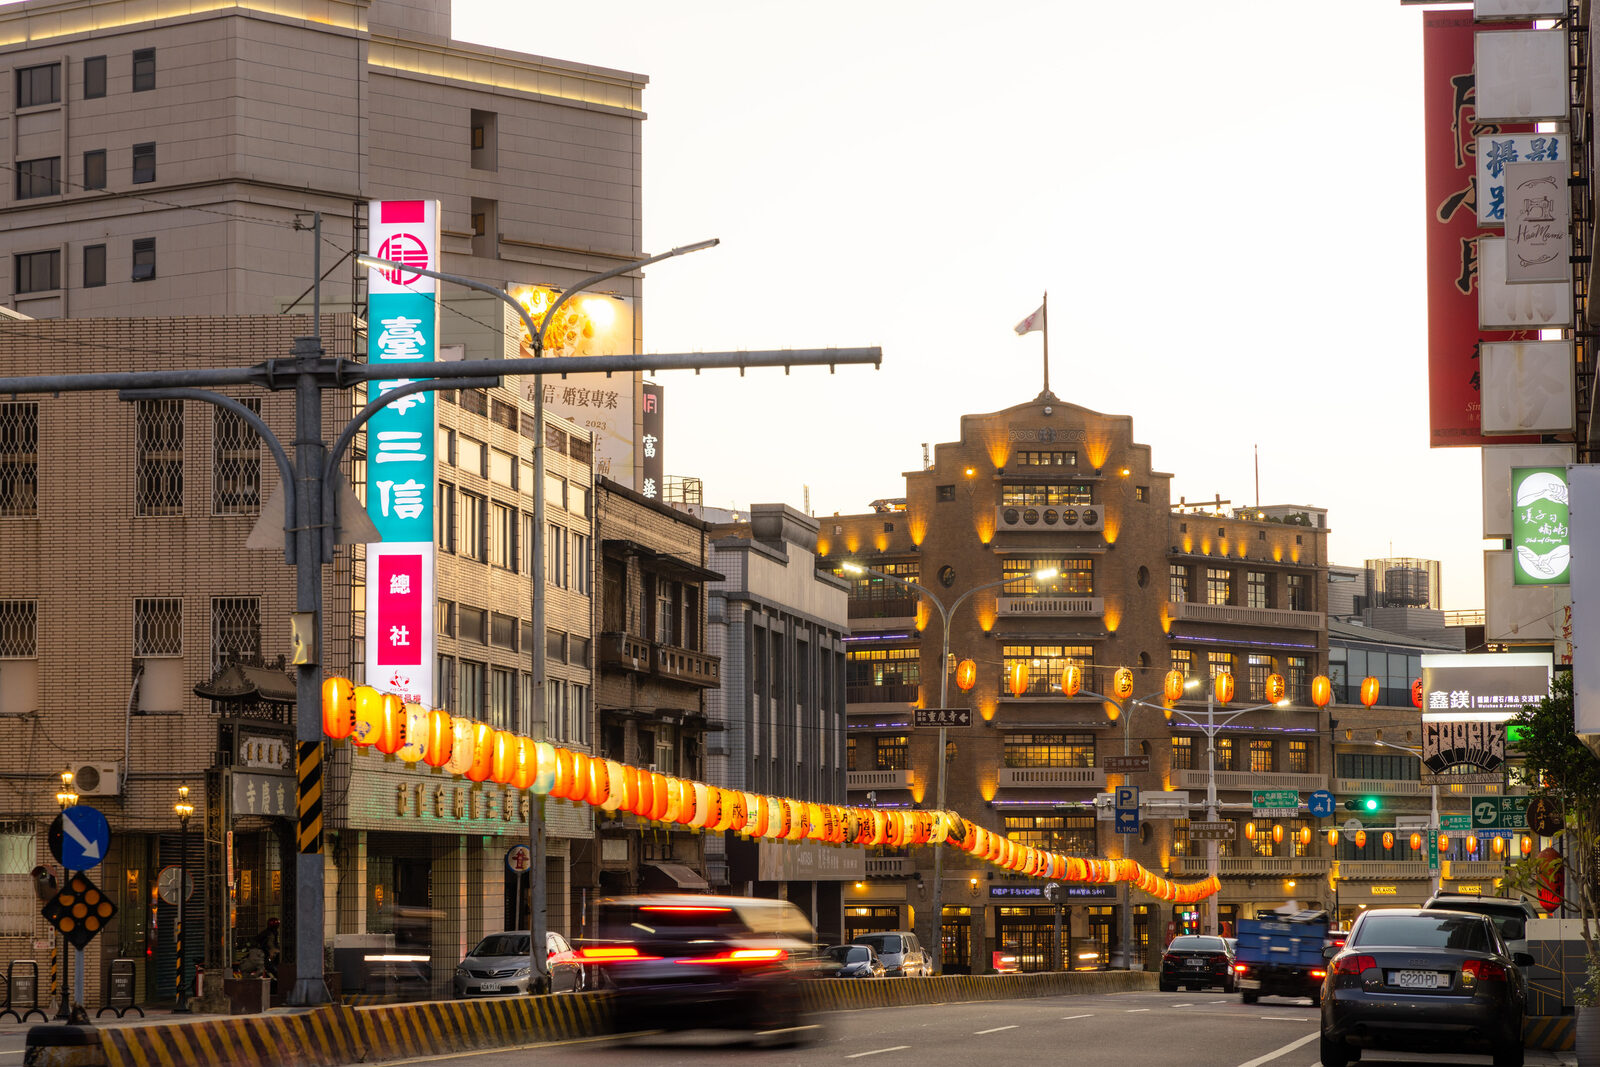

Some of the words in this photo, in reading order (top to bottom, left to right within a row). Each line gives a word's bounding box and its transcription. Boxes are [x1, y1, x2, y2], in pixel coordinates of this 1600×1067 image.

[585, 420, 607, 431] 2023
[389, 574, 411, 646] 總社
[1429, 690, 1470, 709] 鑫鎂
[1120, 790, 1132, 806] P
[1502, 813, 1530, 828] 代客
